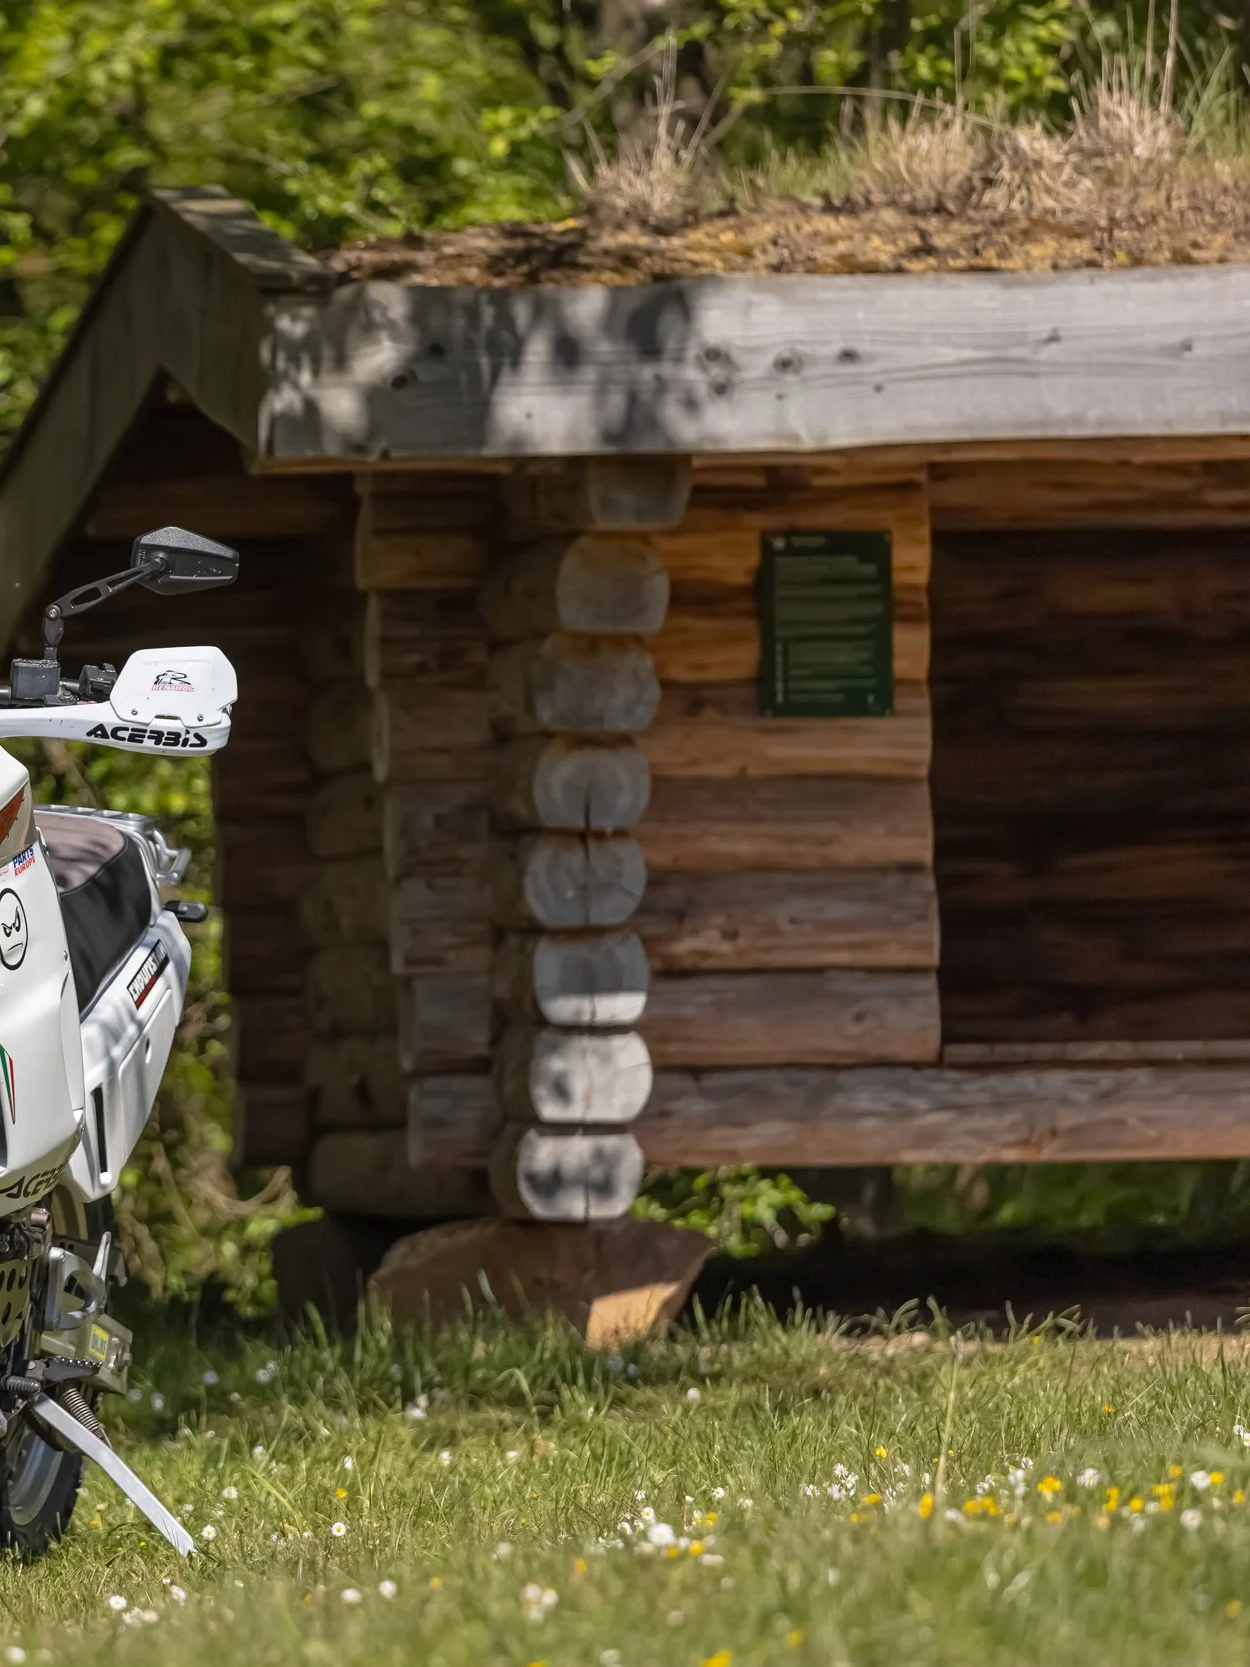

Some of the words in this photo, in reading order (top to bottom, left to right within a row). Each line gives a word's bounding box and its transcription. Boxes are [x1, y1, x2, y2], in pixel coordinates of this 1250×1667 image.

[86, 723, 207, 748] ACERBIS
[12, 847, 34, 869] PARTS
[14, 856, 36, 876] EUROPE
